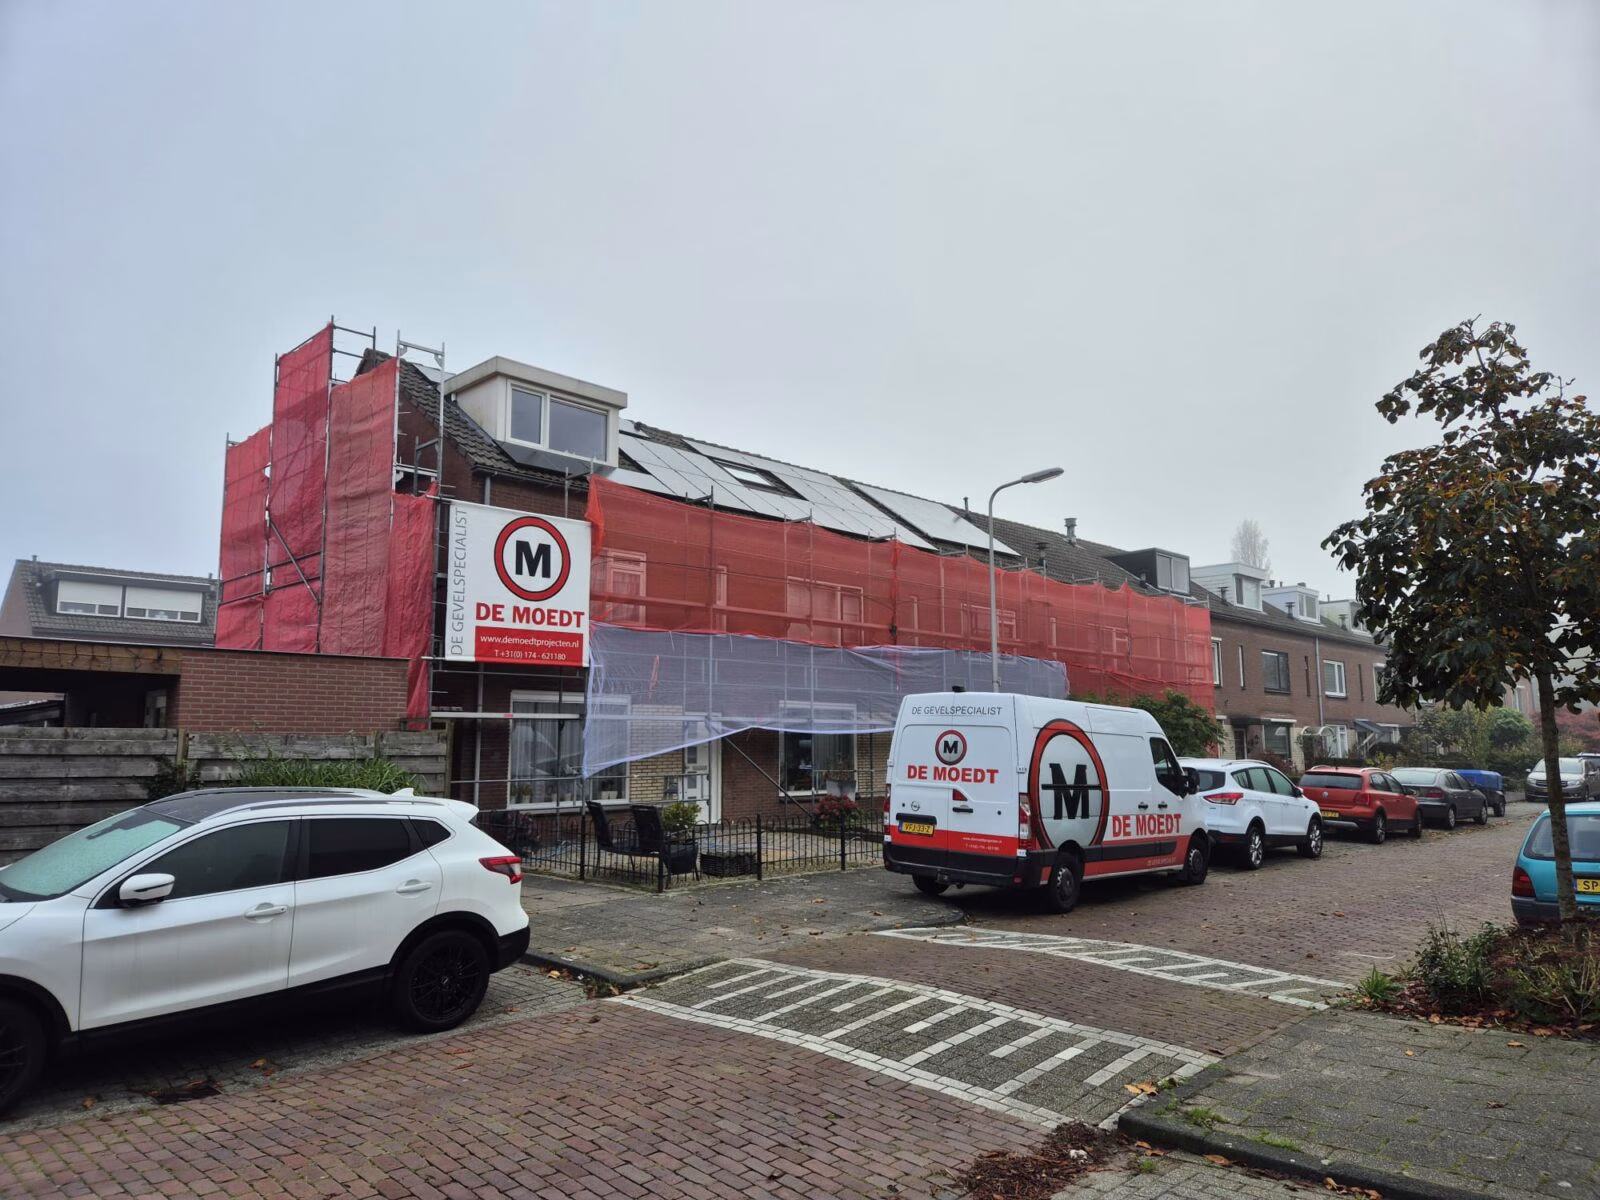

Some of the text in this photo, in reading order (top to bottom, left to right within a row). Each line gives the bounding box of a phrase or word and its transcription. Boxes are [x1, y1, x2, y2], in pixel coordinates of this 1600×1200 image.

[515, 540, 551, 579] M
[451, 507, 468, 656] DE GEVELSPECIALIST
[475, 602, 585, 628] DE MOEDT
[480, 635, 579, 648] www.demoedtprojecten.nl
[494, 649, 499, 657] T
[501, 649, 523, 658] +31(0)
[525, 651, 536, 659] 174
[541, 652, 566, 660] 621180
[911, 705, 1003, 716] DE GEVELSPECIALIST
[943, 740, 959, 754] M
[907, 765, 999, 784] DE MOEDT
[1049, 763, 1090, 820] M
[1112, 813, 1182, 837] DE MOEDT
